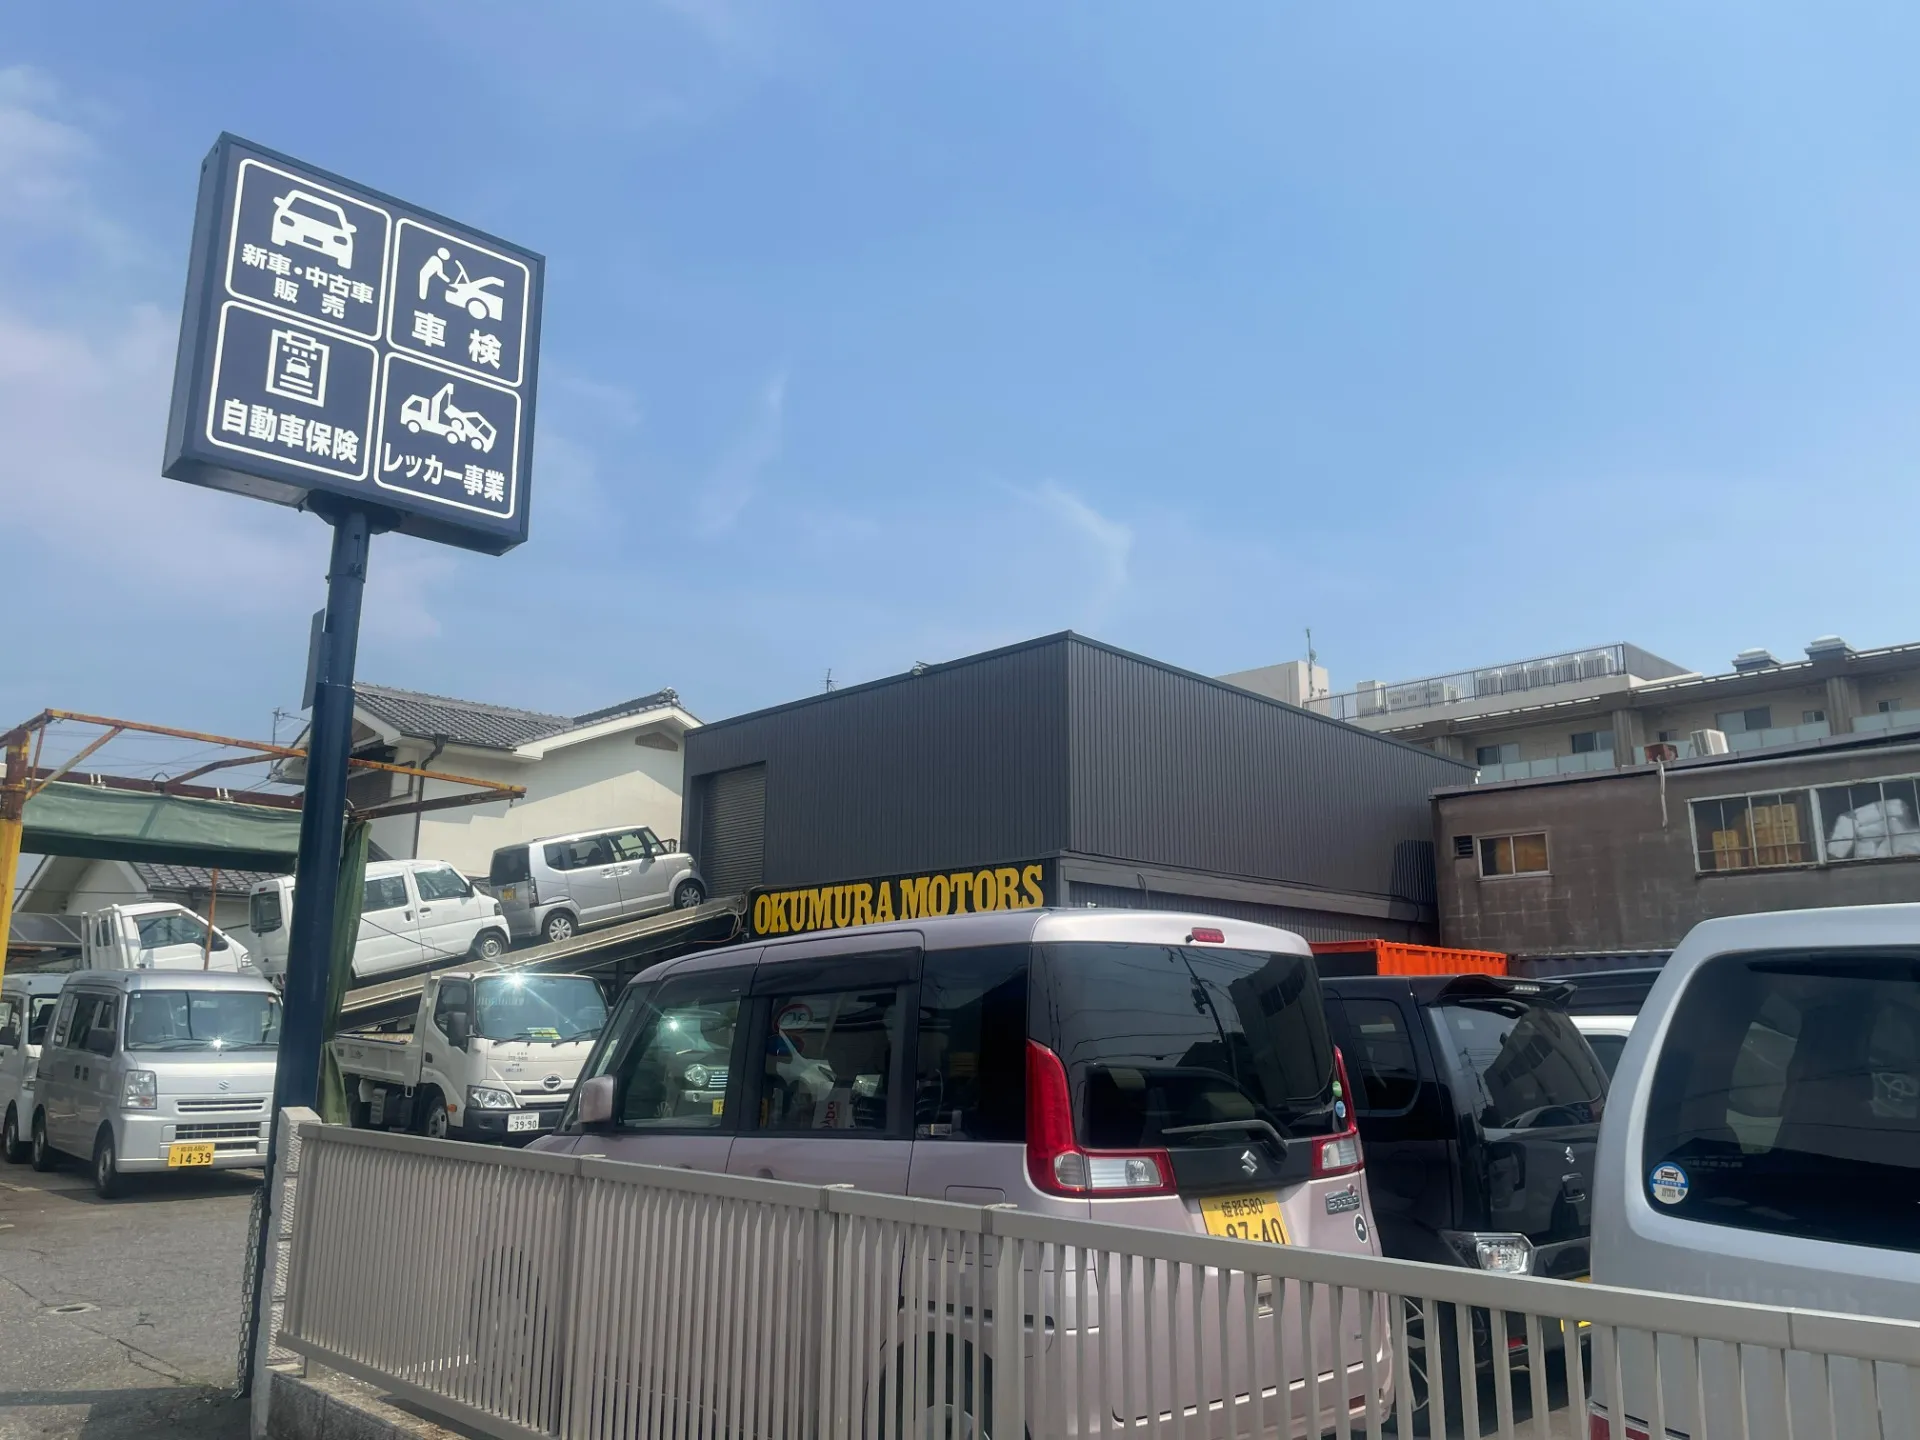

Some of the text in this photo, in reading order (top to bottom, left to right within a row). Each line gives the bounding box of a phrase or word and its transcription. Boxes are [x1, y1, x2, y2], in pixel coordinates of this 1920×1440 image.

[241, 243, 374, 304] 新車・中古車
[221, 398, 360, 465] 自動車保険
[383, 442, 505, 503] レッカー事業
[754, 864, 1044, 935] OKUMURA MOTORS
[179, 1152, 212, 1165] 14-39
